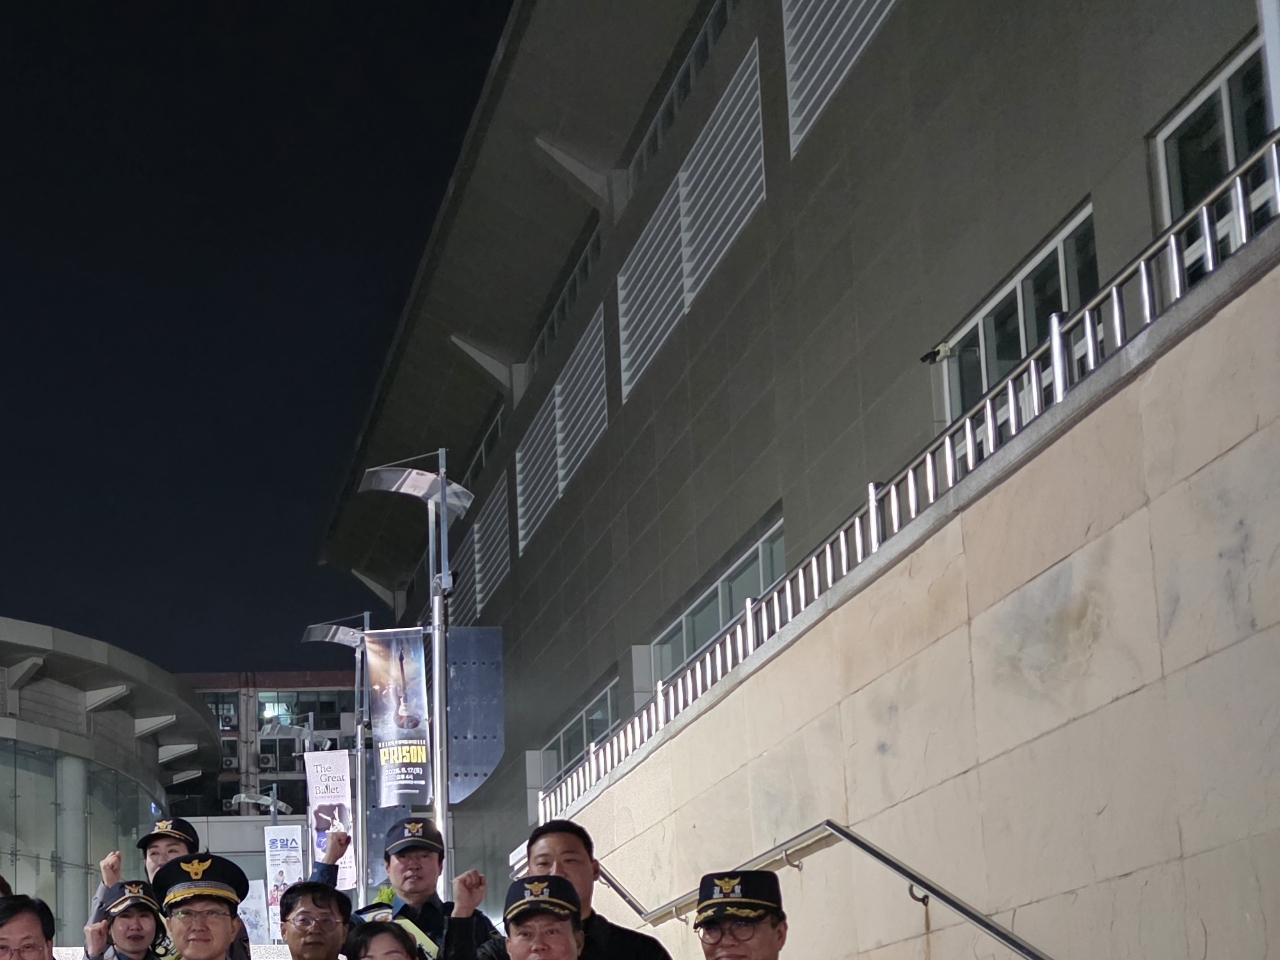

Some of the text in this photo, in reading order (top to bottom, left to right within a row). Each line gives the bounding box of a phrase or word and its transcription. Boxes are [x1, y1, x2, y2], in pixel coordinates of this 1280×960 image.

[380, 746, 426, 766] PRISON
[313, 764, 331, 773] The
[320, 774, 346, 783] Great
[314, 784, 340, 795] Ballet
[269, 838, 299, 849] 옹알스
